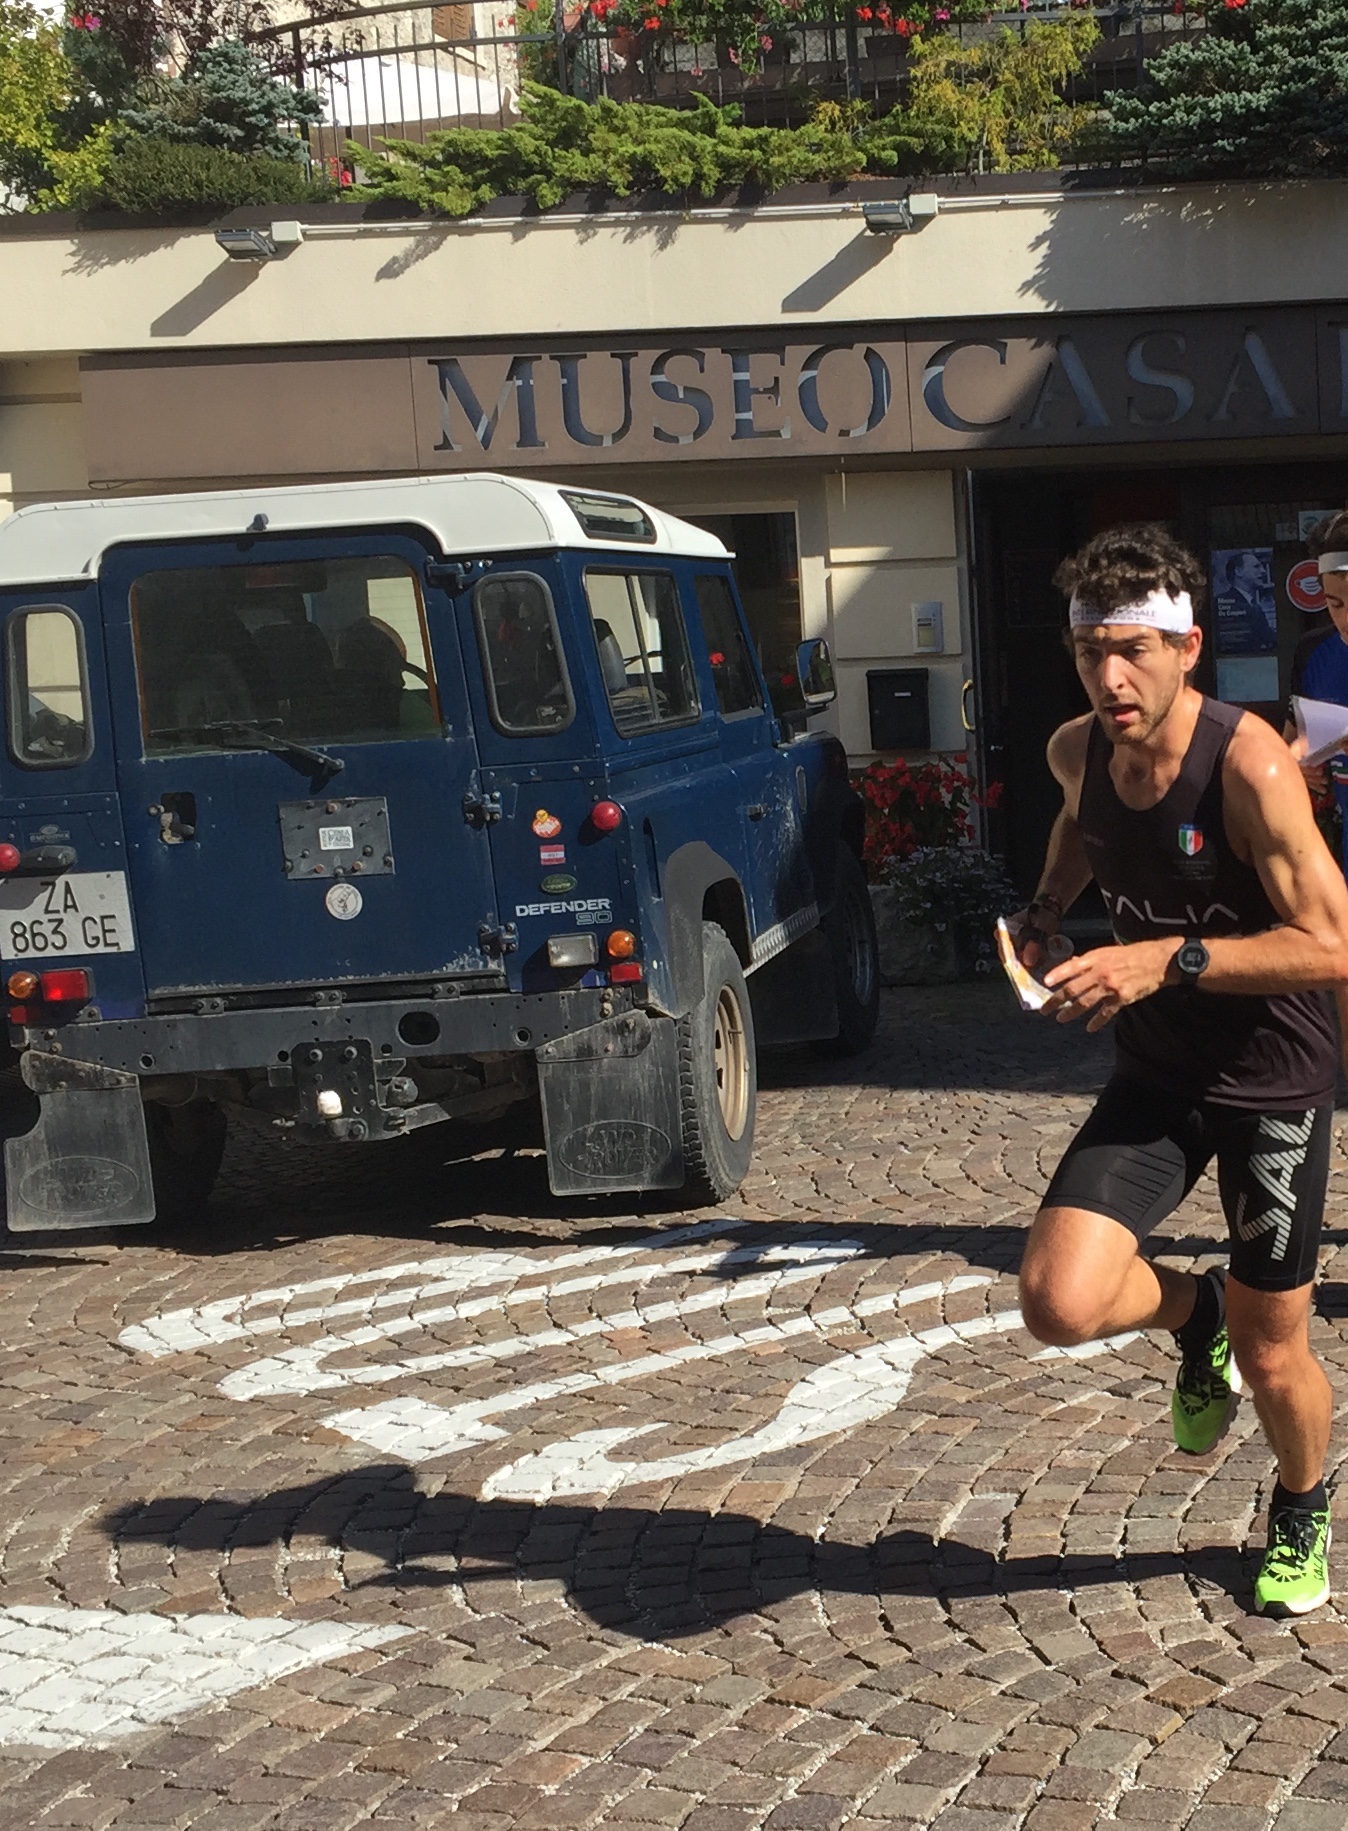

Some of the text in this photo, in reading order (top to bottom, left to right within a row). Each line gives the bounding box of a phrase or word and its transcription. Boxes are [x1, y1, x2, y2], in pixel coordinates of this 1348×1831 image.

[427, 342, 892, 451] MUSEO
[922, 324, 1303, 433] CASA
[40, 880, 79, 915] ZA
[515, 898, 611, 917] DEFENDER
[10, 914, 120, 953] 863 GE
[575, 910, 613, 926] 90
